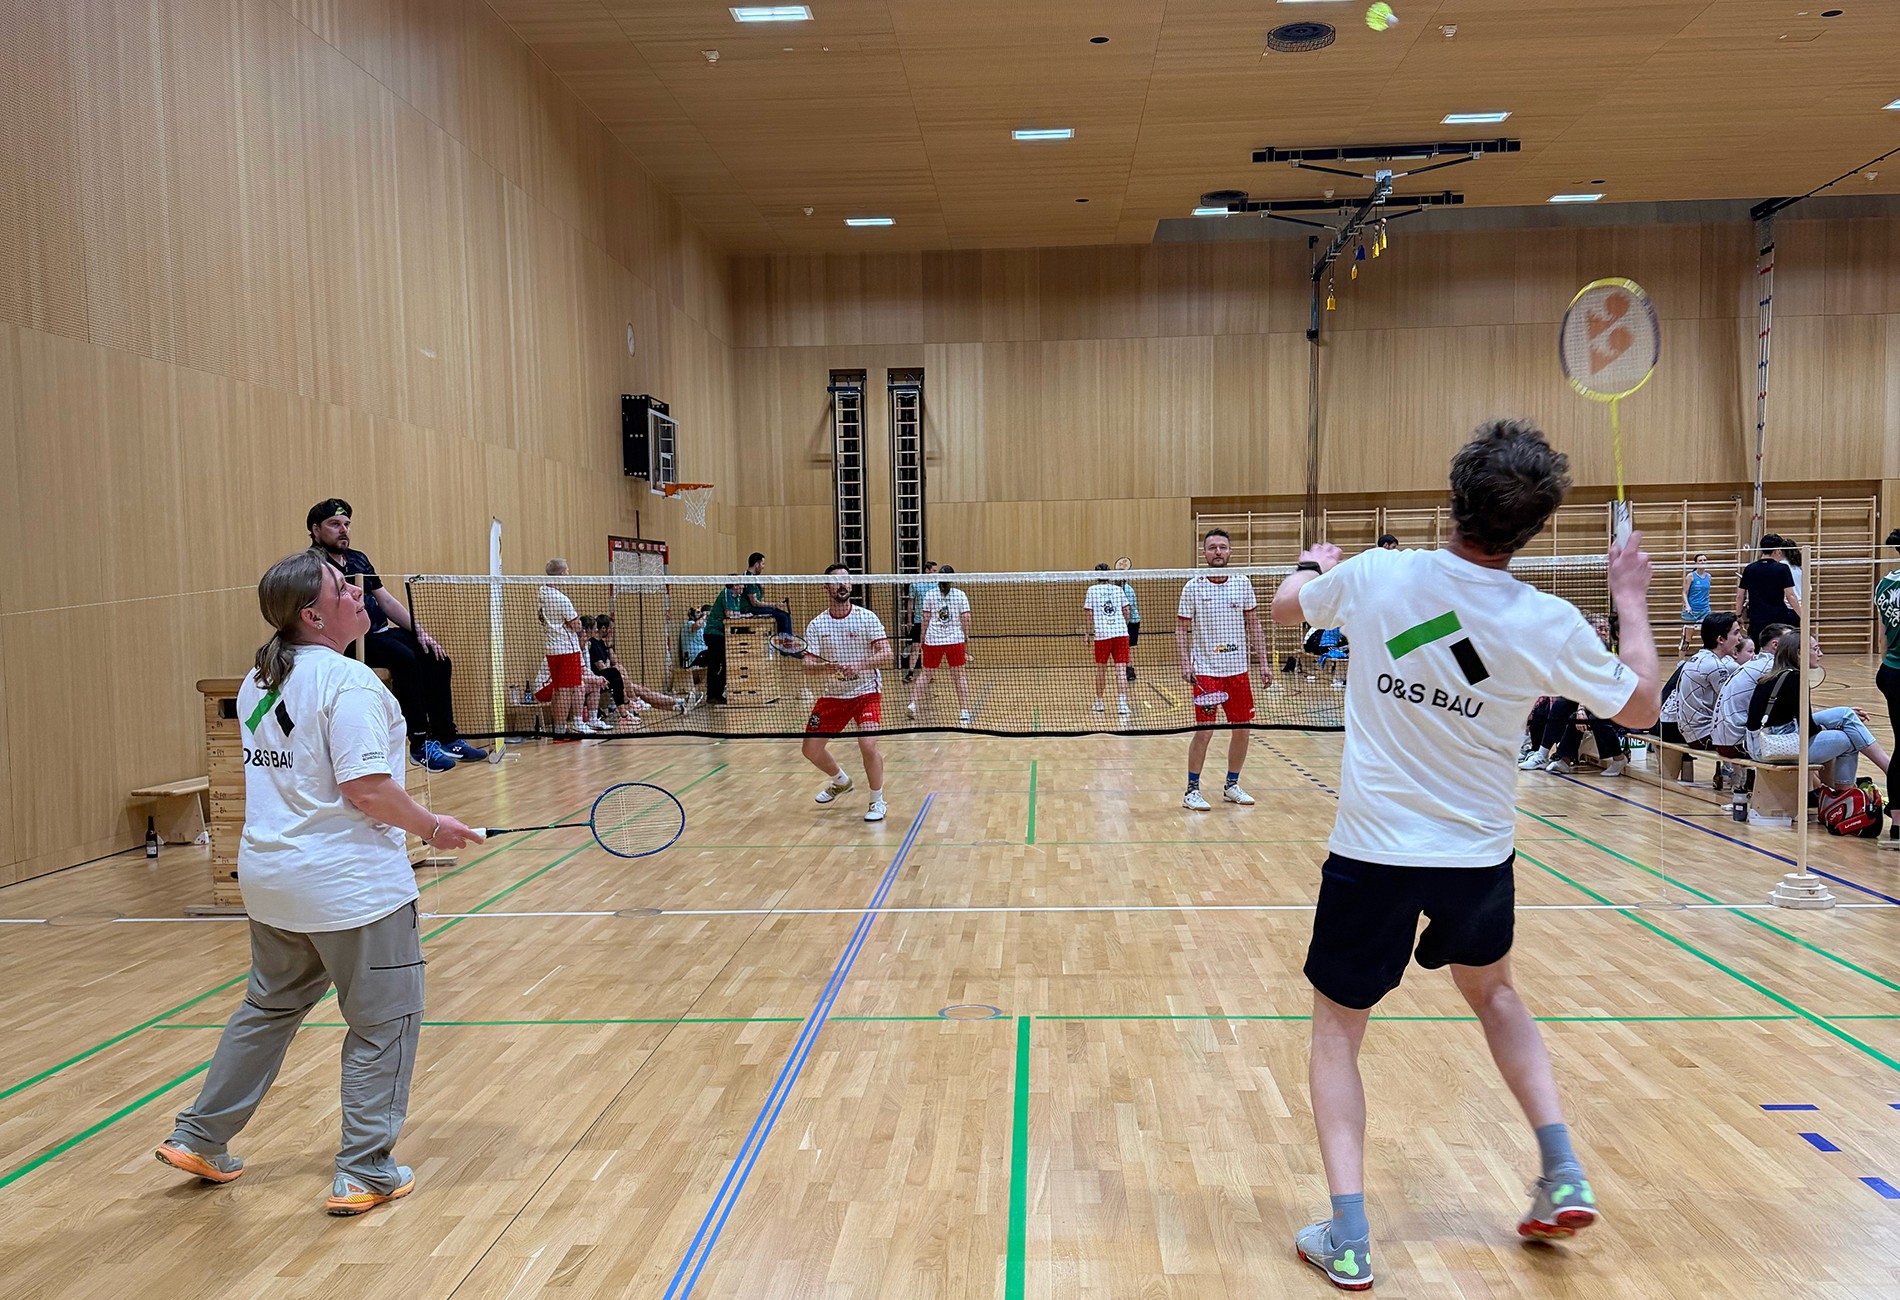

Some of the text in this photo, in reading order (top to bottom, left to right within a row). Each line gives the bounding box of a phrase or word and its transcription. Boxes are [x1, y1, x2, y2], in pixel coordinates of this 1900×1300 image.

[1377, 673, 1484, 718] O&S BAU
[1618, 736, 1646, 747] YNE
[271, 750, 294, 769] BAU
